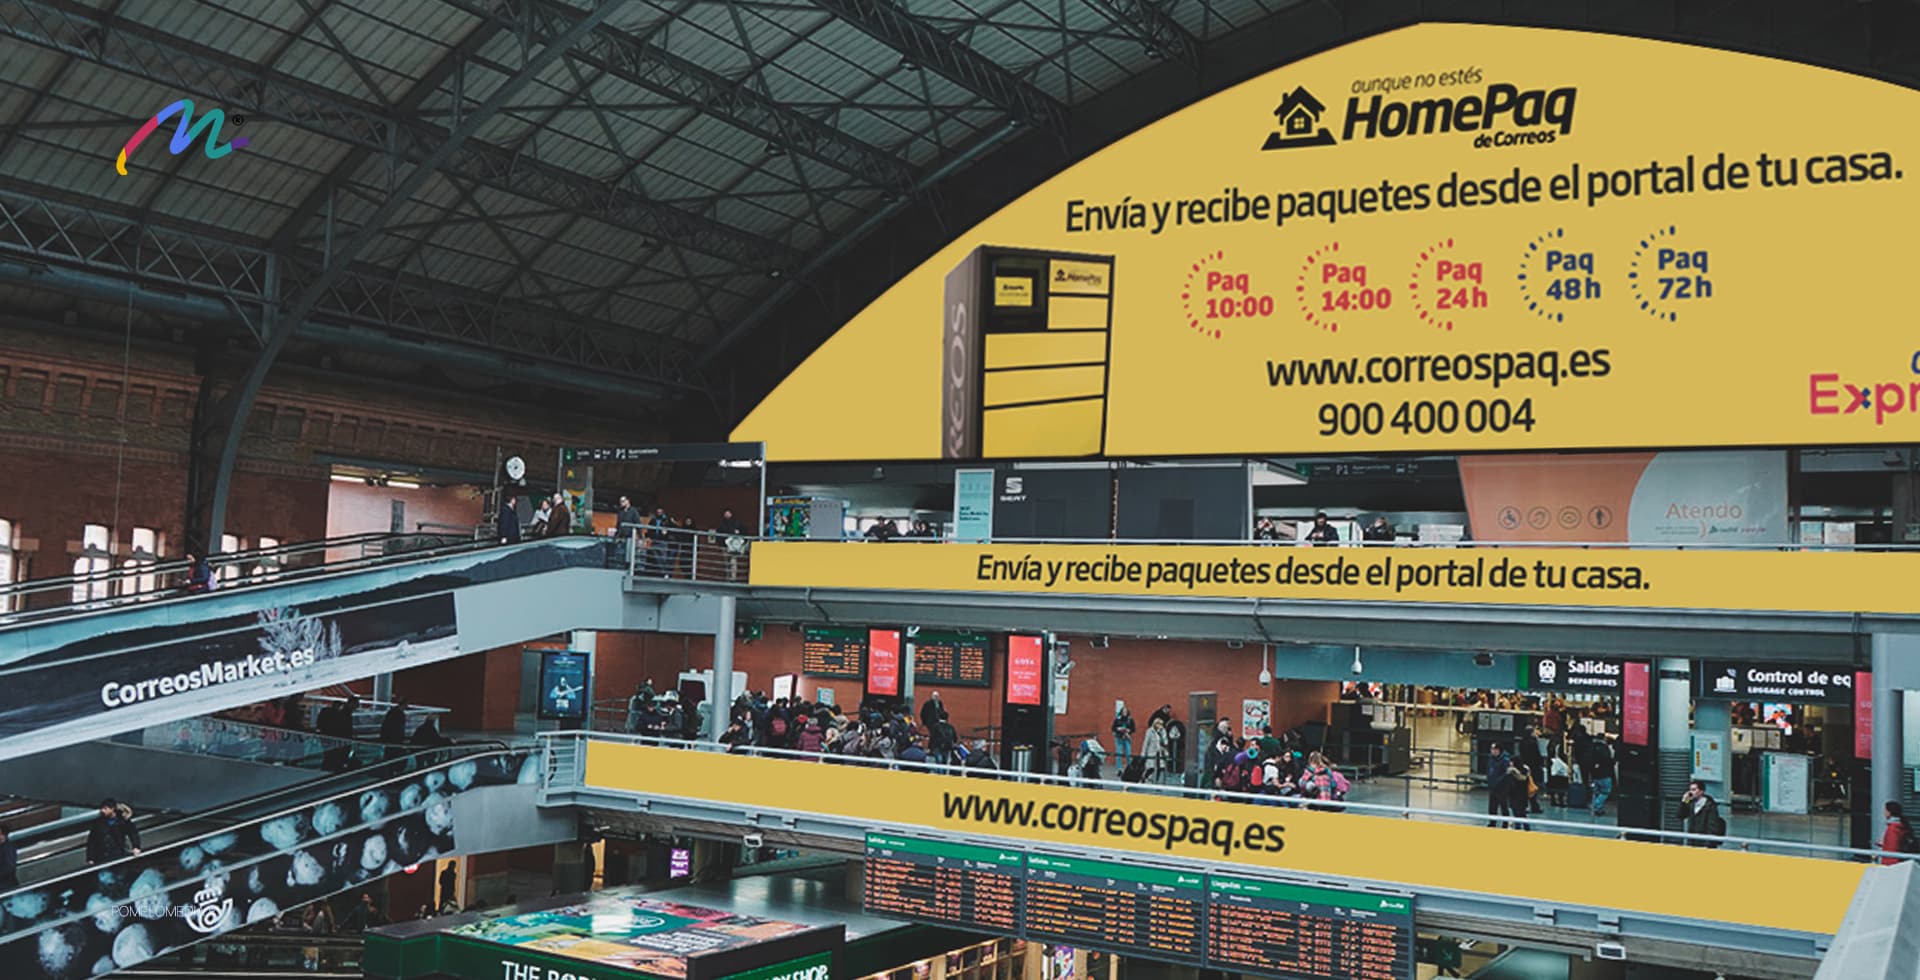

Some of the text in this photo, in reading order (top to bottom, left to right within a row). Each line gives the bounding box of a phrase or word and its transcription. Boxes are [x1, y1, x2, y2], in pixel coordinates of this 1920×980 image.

[1351, 66, 1483, 94] aunque no estés
[1342, 82, 1578, 141] HomePaq
[1066, 151, 1903, 235] Envía y recibe paquetes desde el portal de tu casa.
[1436, 260, 1482, 285] Paq
[1545, 249, 1594, 276] Paq
[1657, 248, 1709, 274] Paq
[1207, 271, 1249, 295] Paq
[1322, 263, 1366, 287] Paq
[1206, 295, 1274, 319] 10:00
[1322, 287, 1392, 312] 14:00
[1266, 349, 1611, 389] www.correospaq.es
[1317, 397, 1536, 437] 900 400 004
[1665, 502, 1743, 519] Atendo
[976, 553, 1650, 593] Envía y recibe paquetes desde el portal de tu casa.
[101, 647, 315, 708] CorreosMarket.es
[1568, 659, 1619, 675] Salidas
[1747, 668, 1852, 689] Control de eq
[1568, 677, 1618, 687] DEPARTURES
[1747, 686, 1825, 697] LUGGAGE CONTROL
[943, 790, 1287, 858] www.correospaq.es
